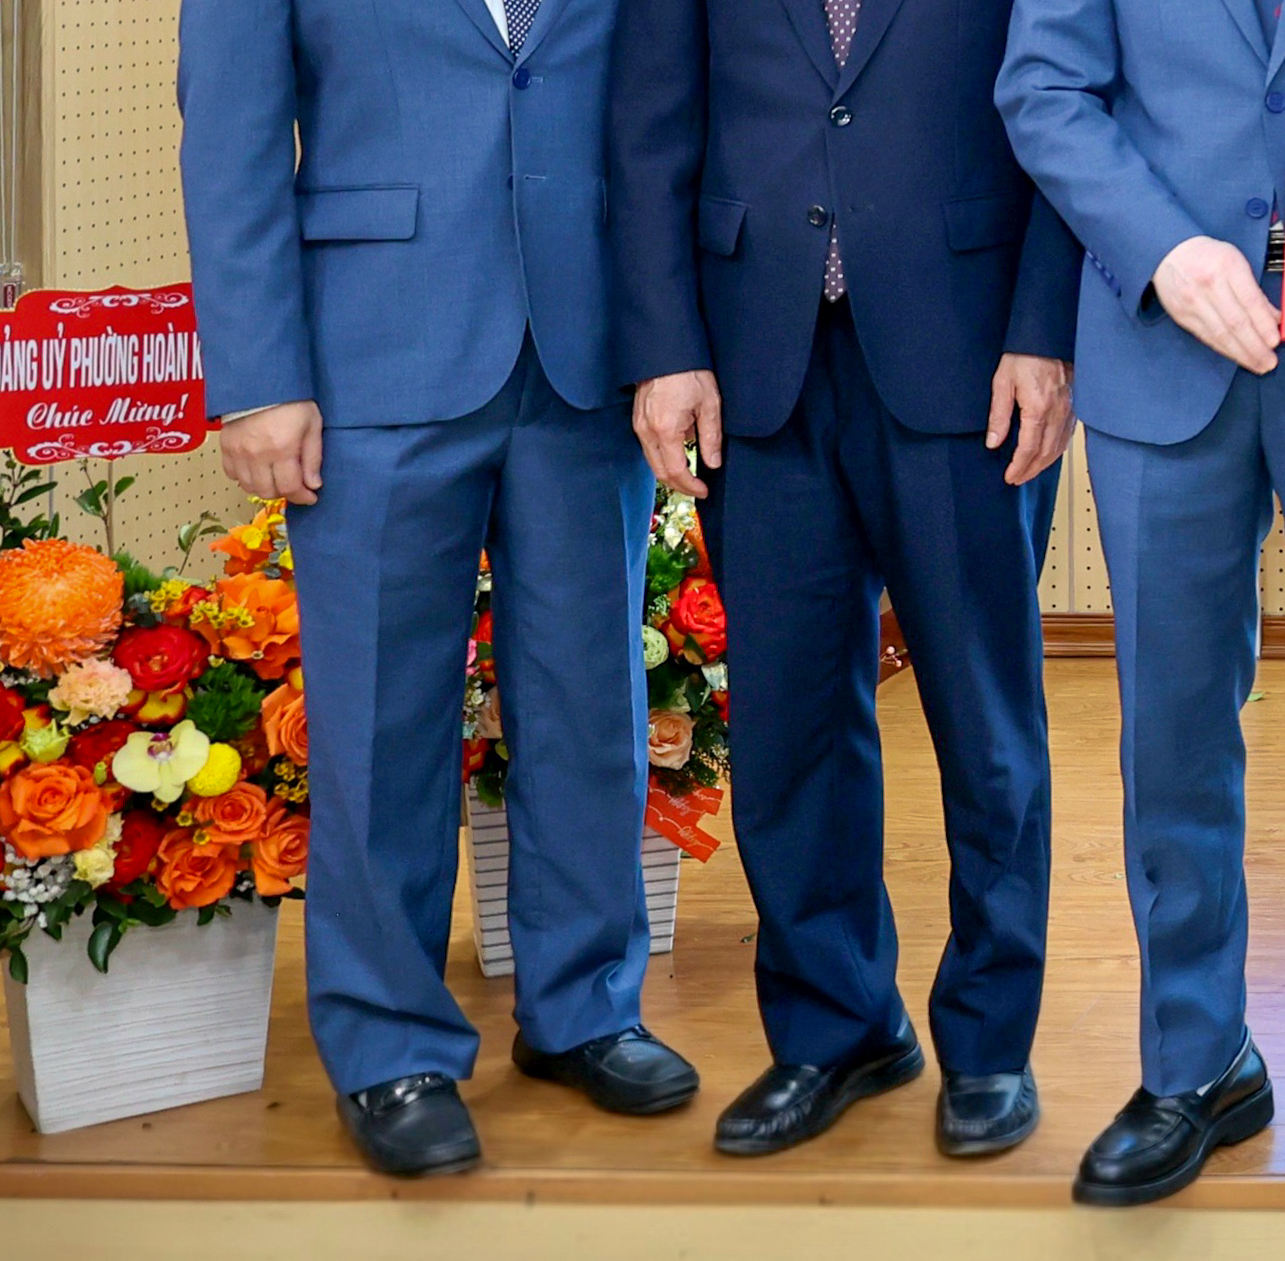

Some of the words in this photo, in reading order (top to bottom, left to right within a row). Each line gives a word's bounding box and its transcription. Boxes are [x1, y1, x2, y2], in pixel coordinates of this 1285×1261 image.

[0, 323, 39, 392] ẢNG
[70, 325, 139, 389] PHƯỜNG
[143, 321, 189, 383] HOÀN
[26, 400, 94, 430] Chúc
[99, 393, 190, 425] Mừng!
